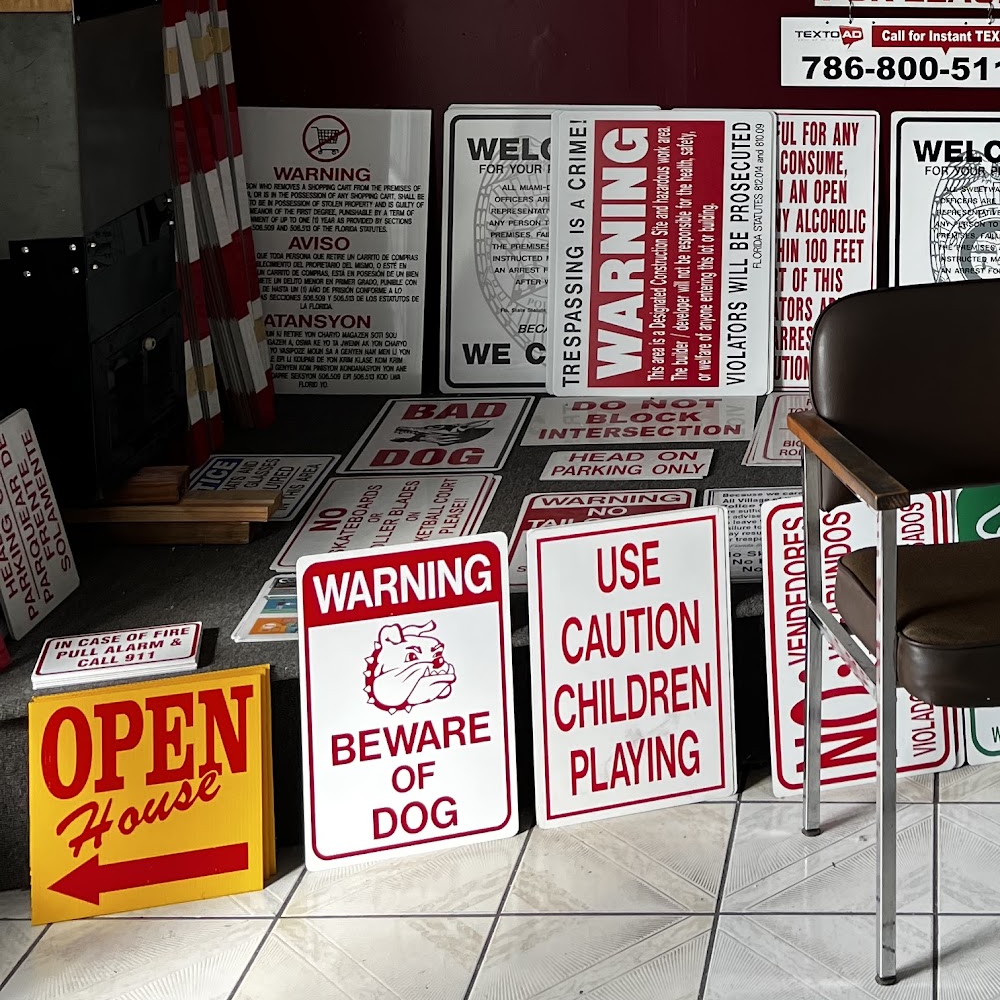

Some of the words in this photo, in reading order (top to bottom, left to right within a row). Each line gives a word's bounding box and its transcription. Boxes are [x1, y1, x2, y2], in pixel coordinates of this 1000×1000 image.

[881, 30, 905, 42] Call
[909, 30, 925, 42] for
[929, 31, 972, 42] Instant
[568, 119, 587, 190] CRIME!
[274, 167, 371, 181] WARNING
[730, 123, 751, 223] PROSECUTED
[570, 200, 585, 209] A
[569, 218, 585, 233] IS
[288, 237, 350, 250] AVISO
[730, 232, 749, 250] BE
[596, 127, 648, 379] WARNING
[729, 259, 748, 294] WILL
[264, 315, 371, 329] ATANSYON
[563, 246, 583, 387] TRESPASSING
[727, 301, 748, 385] VIOLATORS
[401, 402, 508, 419] BAD
[572, 401, 626, 410] DO
[641, 399, 722, 410] NOT
[586, 412, 702, 424] BLOCK
[538, 425, 740, 439] INTERSECTION
[369, 448, 486, 466] DOG
[568, 453, 644, 462] HEAD
[658, 451, 698, 460] ON
[551, 465, 642, 476] PARKING
[652, 464, 705, 474] ONLY
[541, 494, 681, 505] WARNING
[587, 507, 628, 516] NO
[597, 541, 661, 593] USE
[313, 554, 492, 614] WARNING
[55, 641, 72, 649] IN
[79, 636, 120, 646] CASE
[127, 633, 148, 641] OF
[154, 628, 190, 638] FIRE
[562, 600, 700, 665] CAUTION
[56, 649, 100, 659] PULL
[105, 640, 164, 653] ALARM
[171, 638, 182, 646] &
[78, 657, 118, 667] CALL
[125, 651, 154, 661] 911
[554, 663, 712, 732] CHILDREN
[41, 685, 253, 799] OPEN
[331, 711, 491, 766] BEWARE
[571, 730, 700, 796] PLAYING
[392, 761, 435, 793] OF
[56, 770, 222, 858] House
[373, 796, 458, 840] DOG
